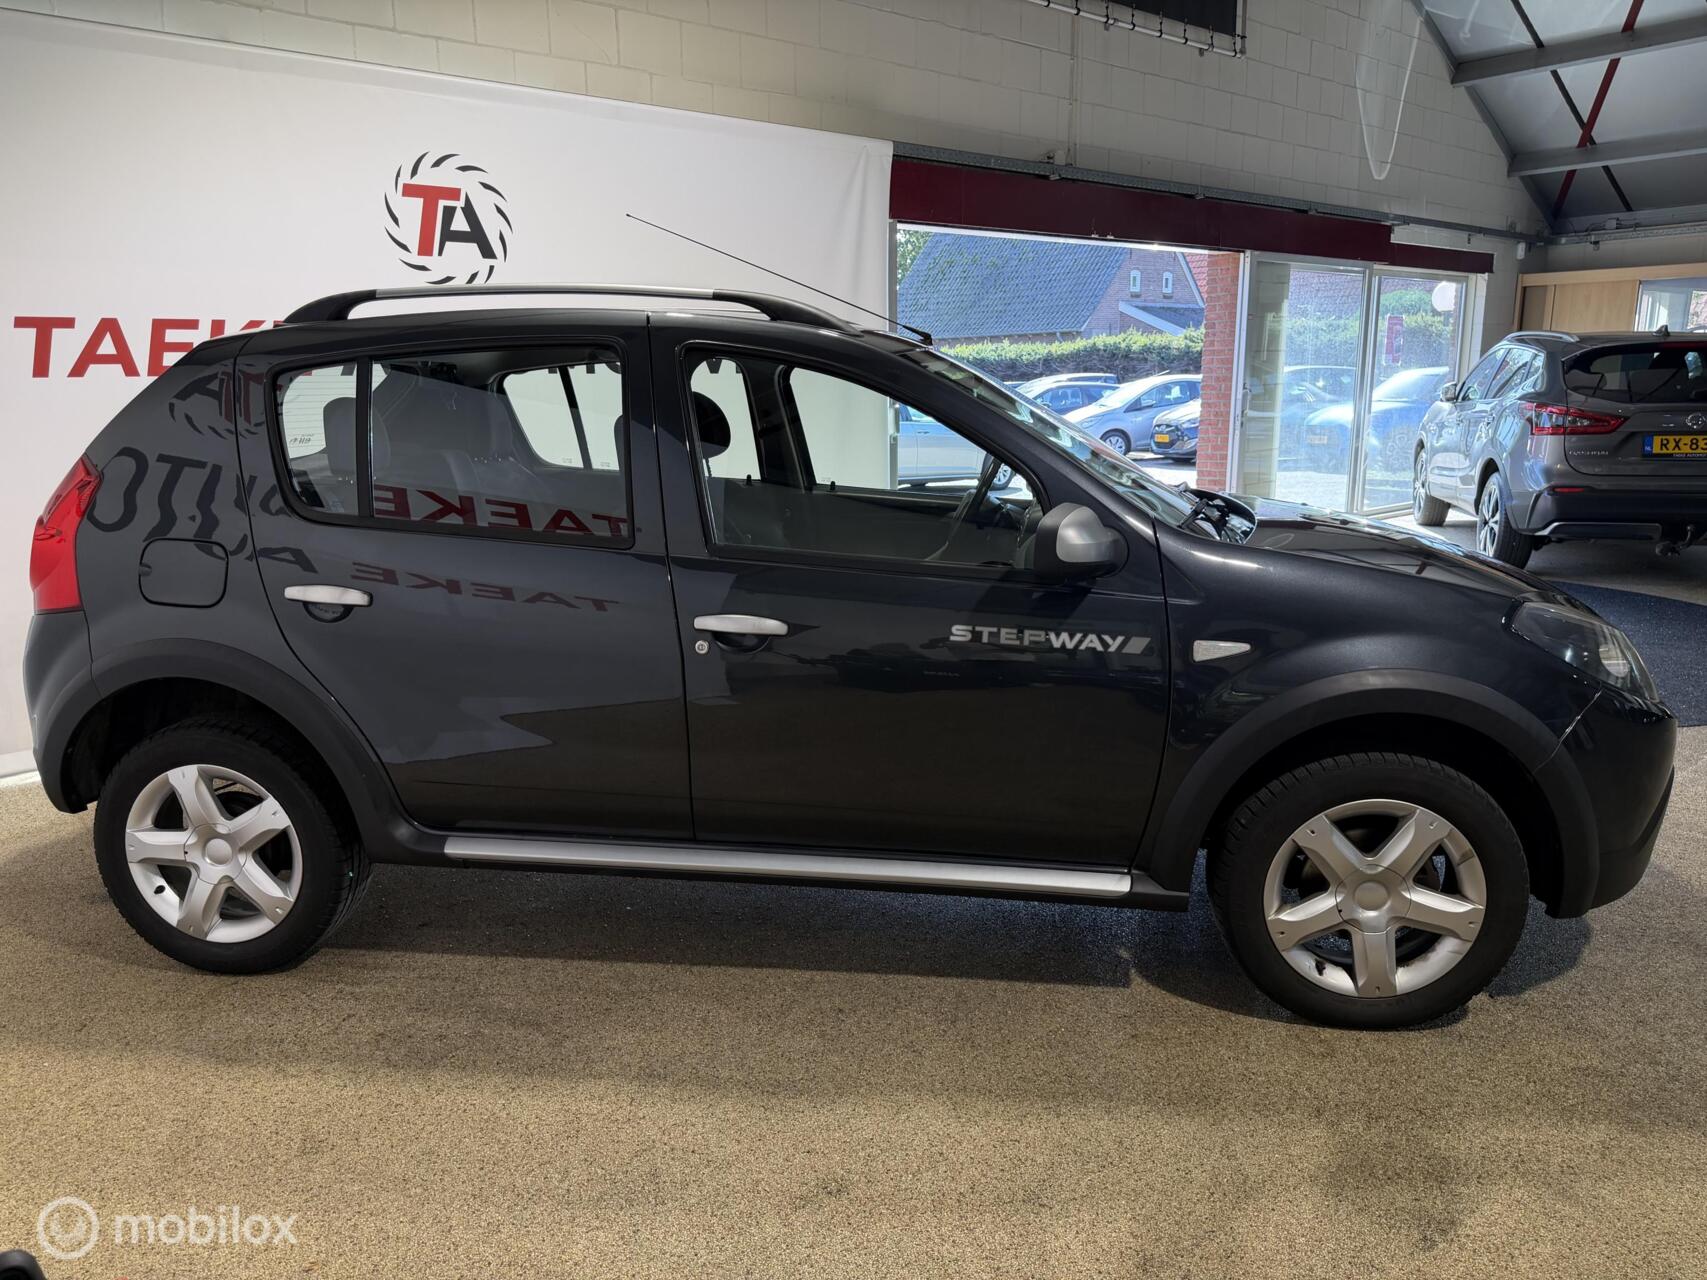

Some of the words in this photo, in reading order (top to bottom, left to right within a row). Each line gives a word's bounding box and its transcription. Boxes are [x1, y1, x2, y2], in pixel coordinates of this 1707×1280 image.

[401, 182, 498, 260] TA
[13, 316, 284, 378] TAE
[949, 624, 1125, 653] STEPWAY
